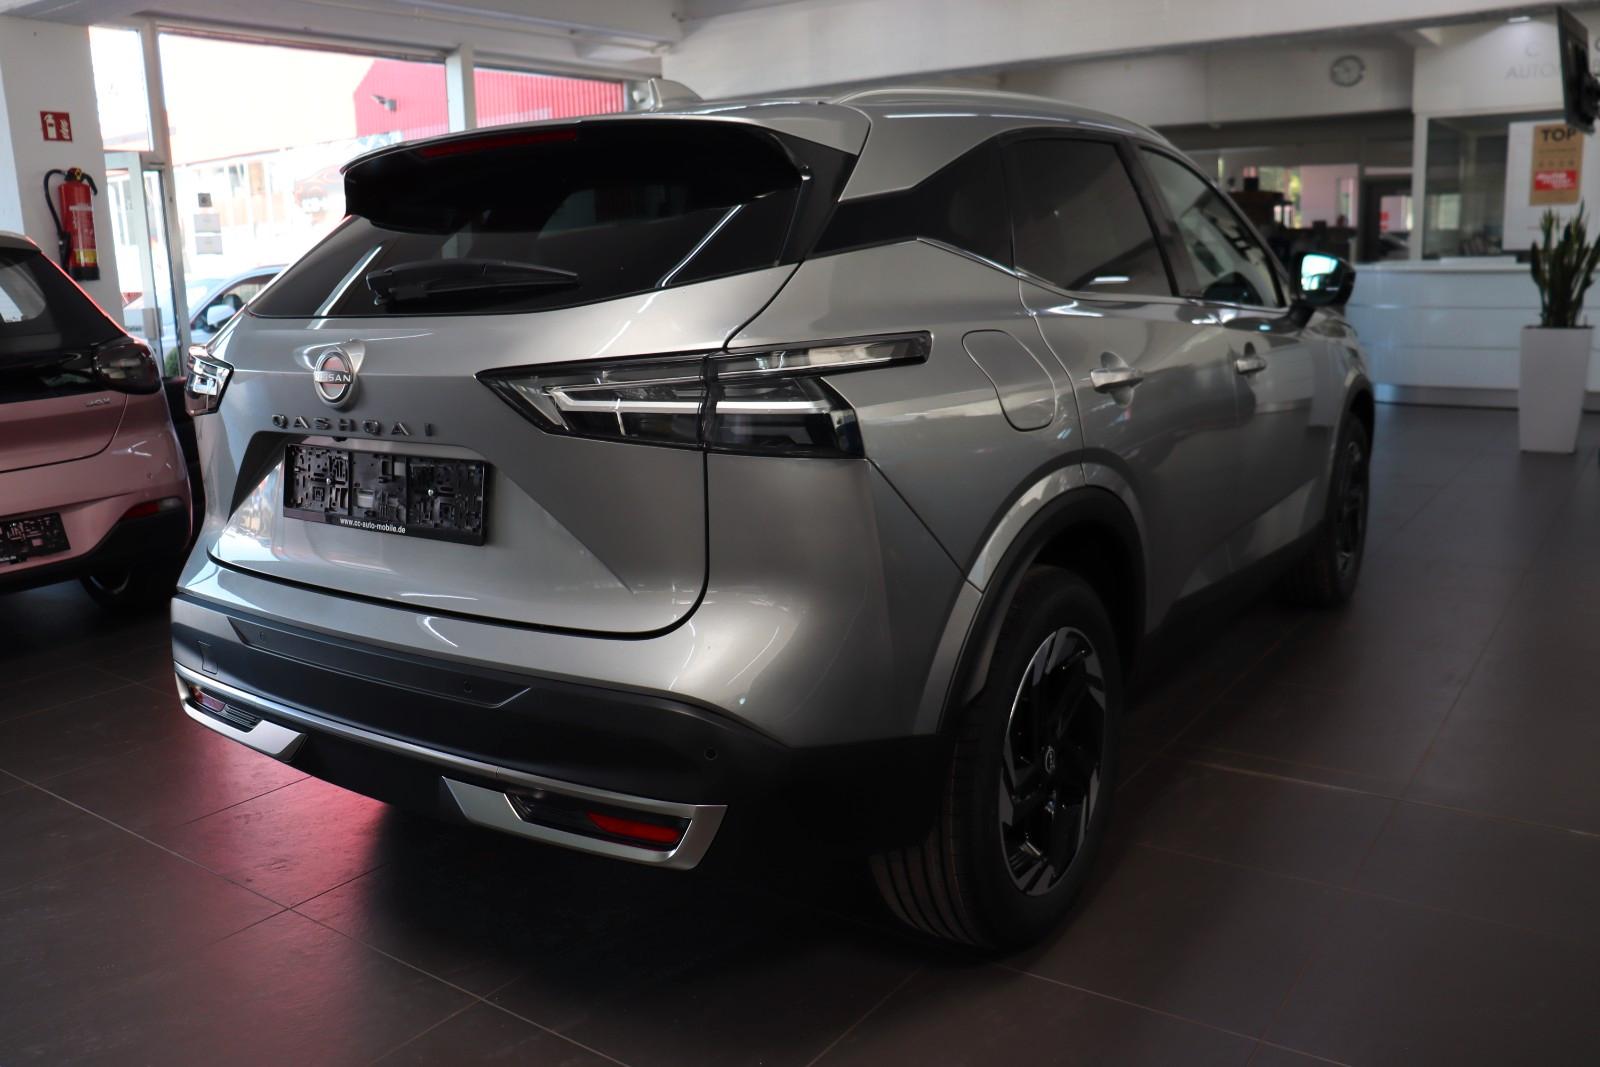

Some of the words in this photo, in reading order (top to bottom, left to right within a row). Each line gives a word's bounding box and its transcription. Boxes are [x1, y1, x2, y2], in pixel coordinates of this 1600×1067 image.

[1541, 128, 1577, 142] TOP
[315, 373, 351, 383] NISSAN
[272, 413, 434, 437] QASHQAI
